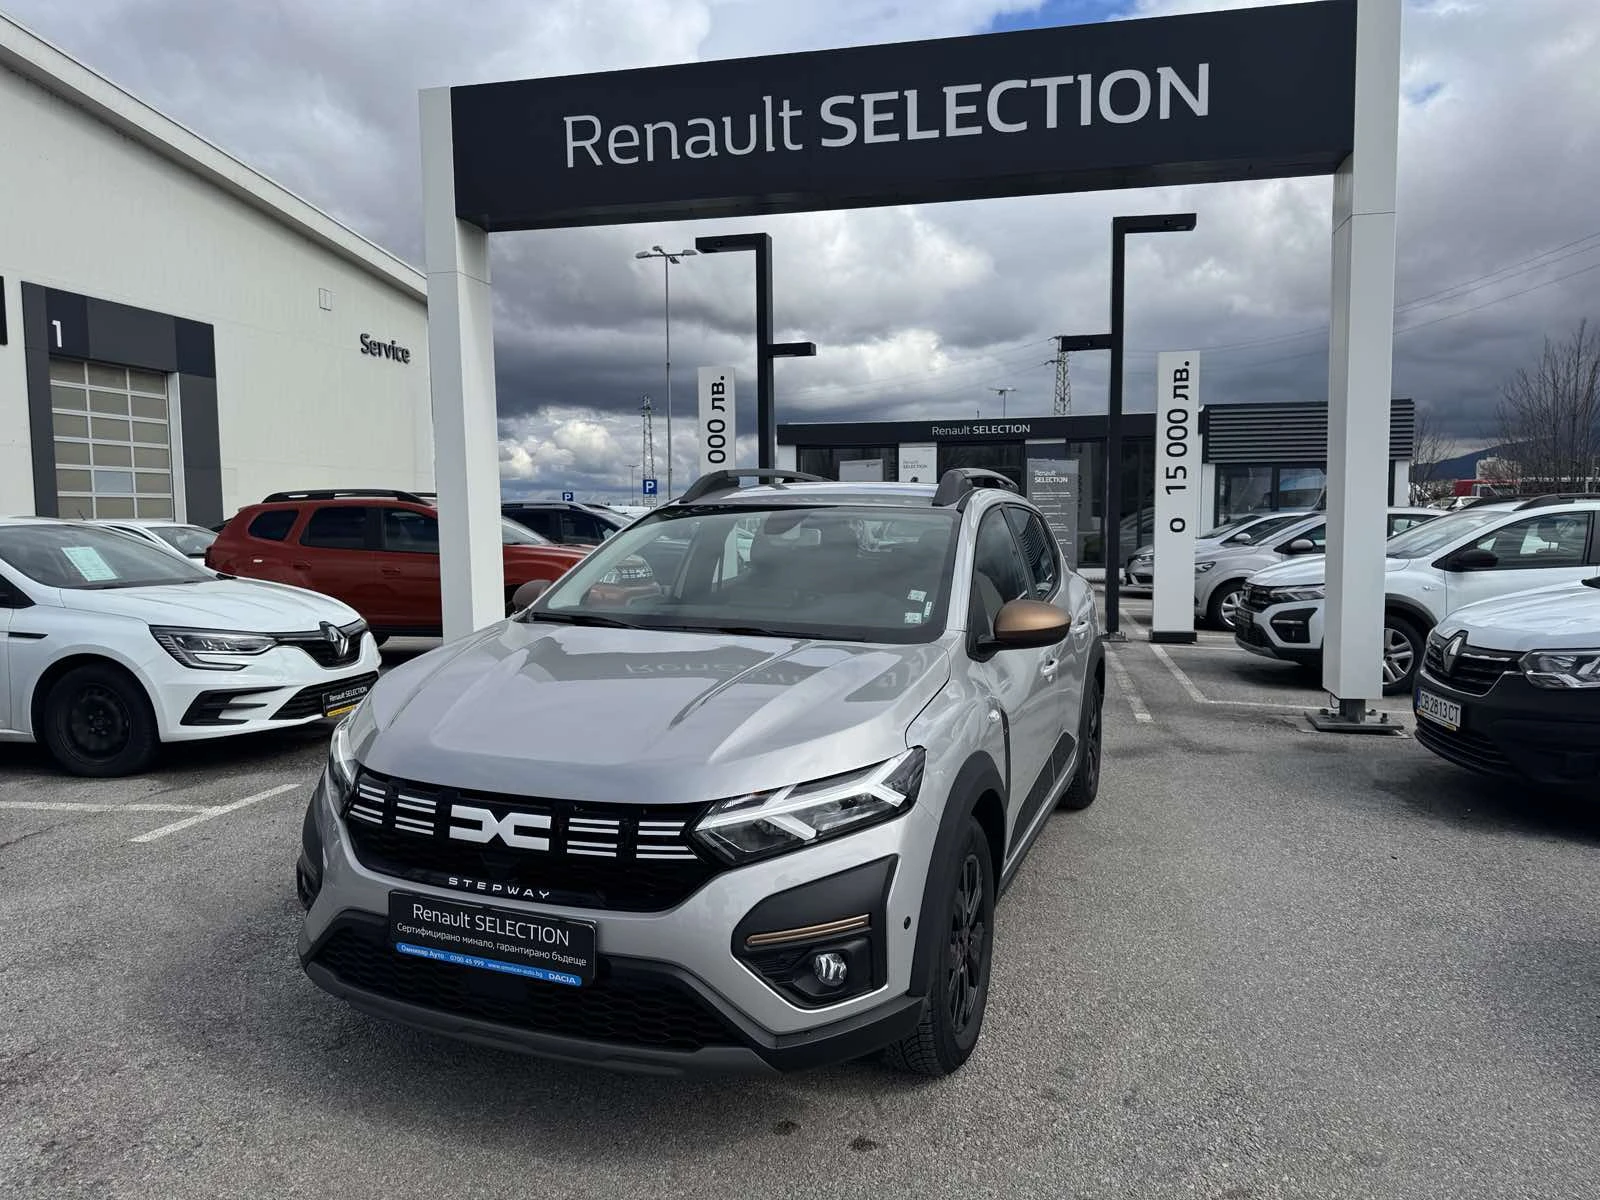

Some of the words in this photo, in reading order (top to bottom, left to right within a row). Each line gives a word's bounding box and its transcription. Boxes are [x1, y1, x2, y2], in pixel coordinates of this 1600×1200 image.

[563, 96, 803, 168] Renault
[820, 63, 1210, 147] SELECTION
[52, 320, 63, 348] 1
[360, 333, 411, 364] Service
[712, 375, 725, 412] лв.
[1173, 361, 1190, 400] лв.
[707, 419, 726, 464] 000
[932, 425, 970, 437] Renault
[972, 423, 1031, 435] SELECTION
[1165, 408, 1189, 458] 000
[645, 481, 655, 493] P
[1165, 465, 1187, 495] 15
[564, 493, 572, 501] P
[345, 686, 368, 698] SELECTION
[448, 877, 550, 899] STEPWAY
[413, 903, 471, 929] Renault
[475, 915, 569, 947] SELECTION
[396, 922, 461, 942] Сертифицирано
[462, 936, 495, 950] минало,
[496, 943, 550, 960] гарантирано
[551, 951, 587, 967] бъдеще
[548, 973, 576, 984] DACIA
